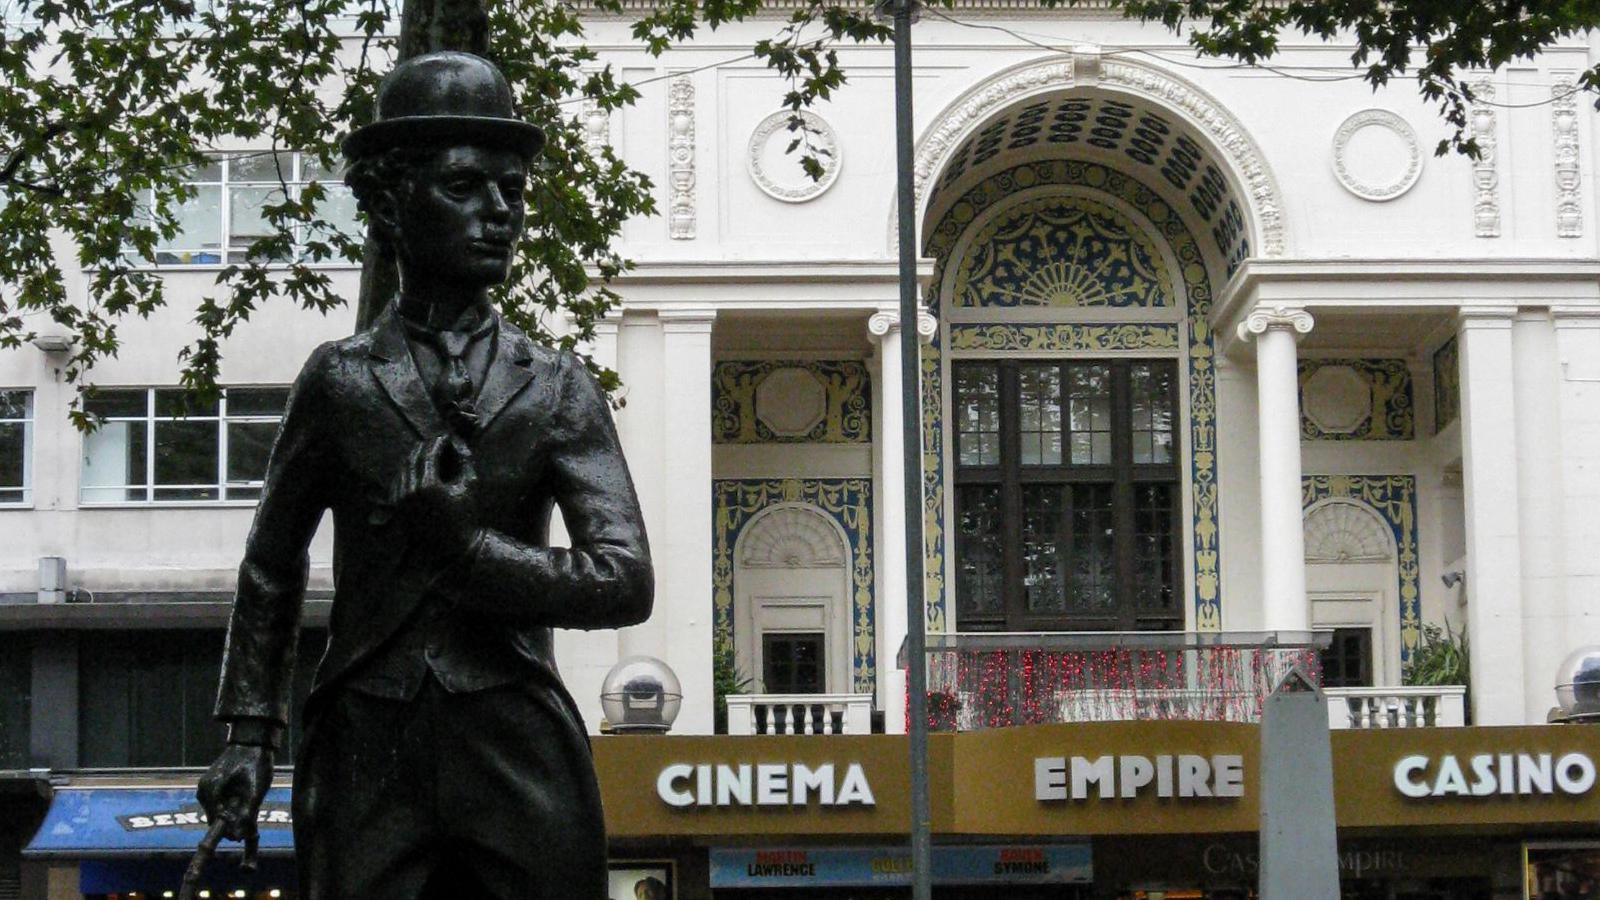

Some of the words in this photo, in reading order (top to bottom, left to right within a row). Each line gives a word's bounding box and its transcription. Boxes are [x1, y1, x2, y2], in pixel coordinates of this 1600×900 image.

[656, 763, 876, 807] CINEMA
[1035, 755, 1245, 801] EMPIRE
[1393, 753, 1597, 798] CASINO
[129, 812, 197, 828] BEN
[748, 863, 816, 877] LAWRENCE
